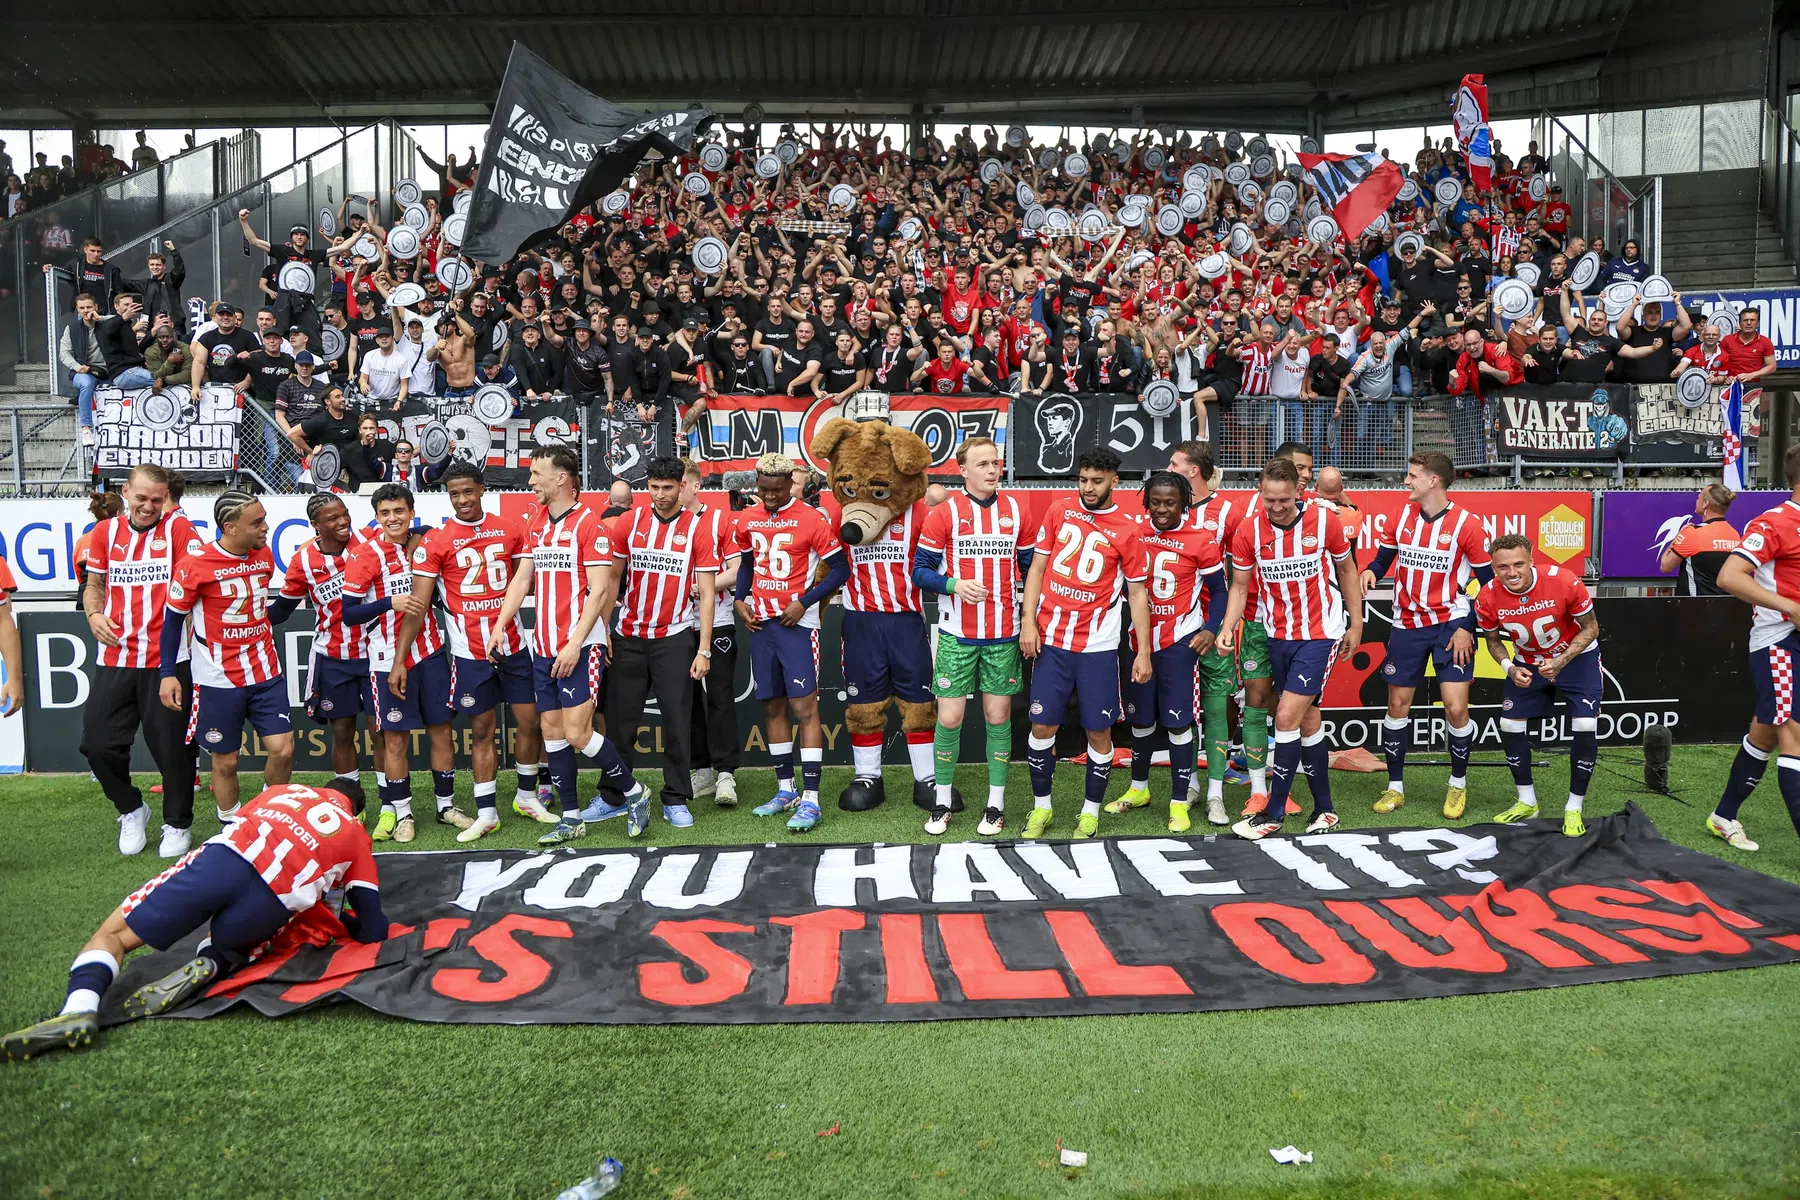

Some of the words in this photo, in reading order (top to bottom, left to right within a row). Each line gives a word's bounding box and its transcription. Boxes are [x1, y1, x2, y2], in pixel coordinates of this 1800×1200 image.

[408, 211, 424, 226] 26
[700, 244, 718, 264] 26
[1575, 264, 1591, 279] 26
[1505, 293, 1523, 308] 26
[1616, 287, 1632, 298] 26
[149, 398, 170, 418] 26
[483, 396, 503, 414] 26
[1503, 396, 1593, 432] VAK-T
[698, 407, 785, 462] LM
[1505, 428, 1596, 450] GENERATIE
[1600, 430, 1610, 449] 2
[747, 519, 799, 529] goodhabitz
[1541, 521, 1583, 534] BETROKKEN
[959, 541, 1013, 549] BRAINPORT
[1545, 534, 1583, 547] SPARTAAN
[533, 553, 571, 561] RAINPORT
[750, 532, 794, 580] 26
[854, 546, 904, 555] BRAINPORT
[855, 553, 905, 563] EINDHOVEN
[959, 548, 1013, 556] EINDHOVEN
[1052, 522, 1111, 585] 26
[632, 554, 684, 566] BRAINPORT
[633, 561, 683, 573] EINDHOVEN
[1262, 561, 1318, 573] BRAINPORT
[109, 565, 168, 575] BRAINPORT
[214, 560, 271, 580] goodhabitz
[456, 543, 509, 596] 26
[110, 573, 169, 584] EINDHOVEN
[219, 573, 269, 624] 26
[1498, 599, 1555, 619] goodhabitz
[1502, 614, 1561, 652] 26
[268, 784, 353, 836] 26
[253, 807, 319, 851] KAMPIOEN
[447, 850, 754, 912] YOU
[814, 838, 1247, 906] HAVE
[1252, 828, 1500, 890] IT?
[638, 909, 1196, 1006] STILL
